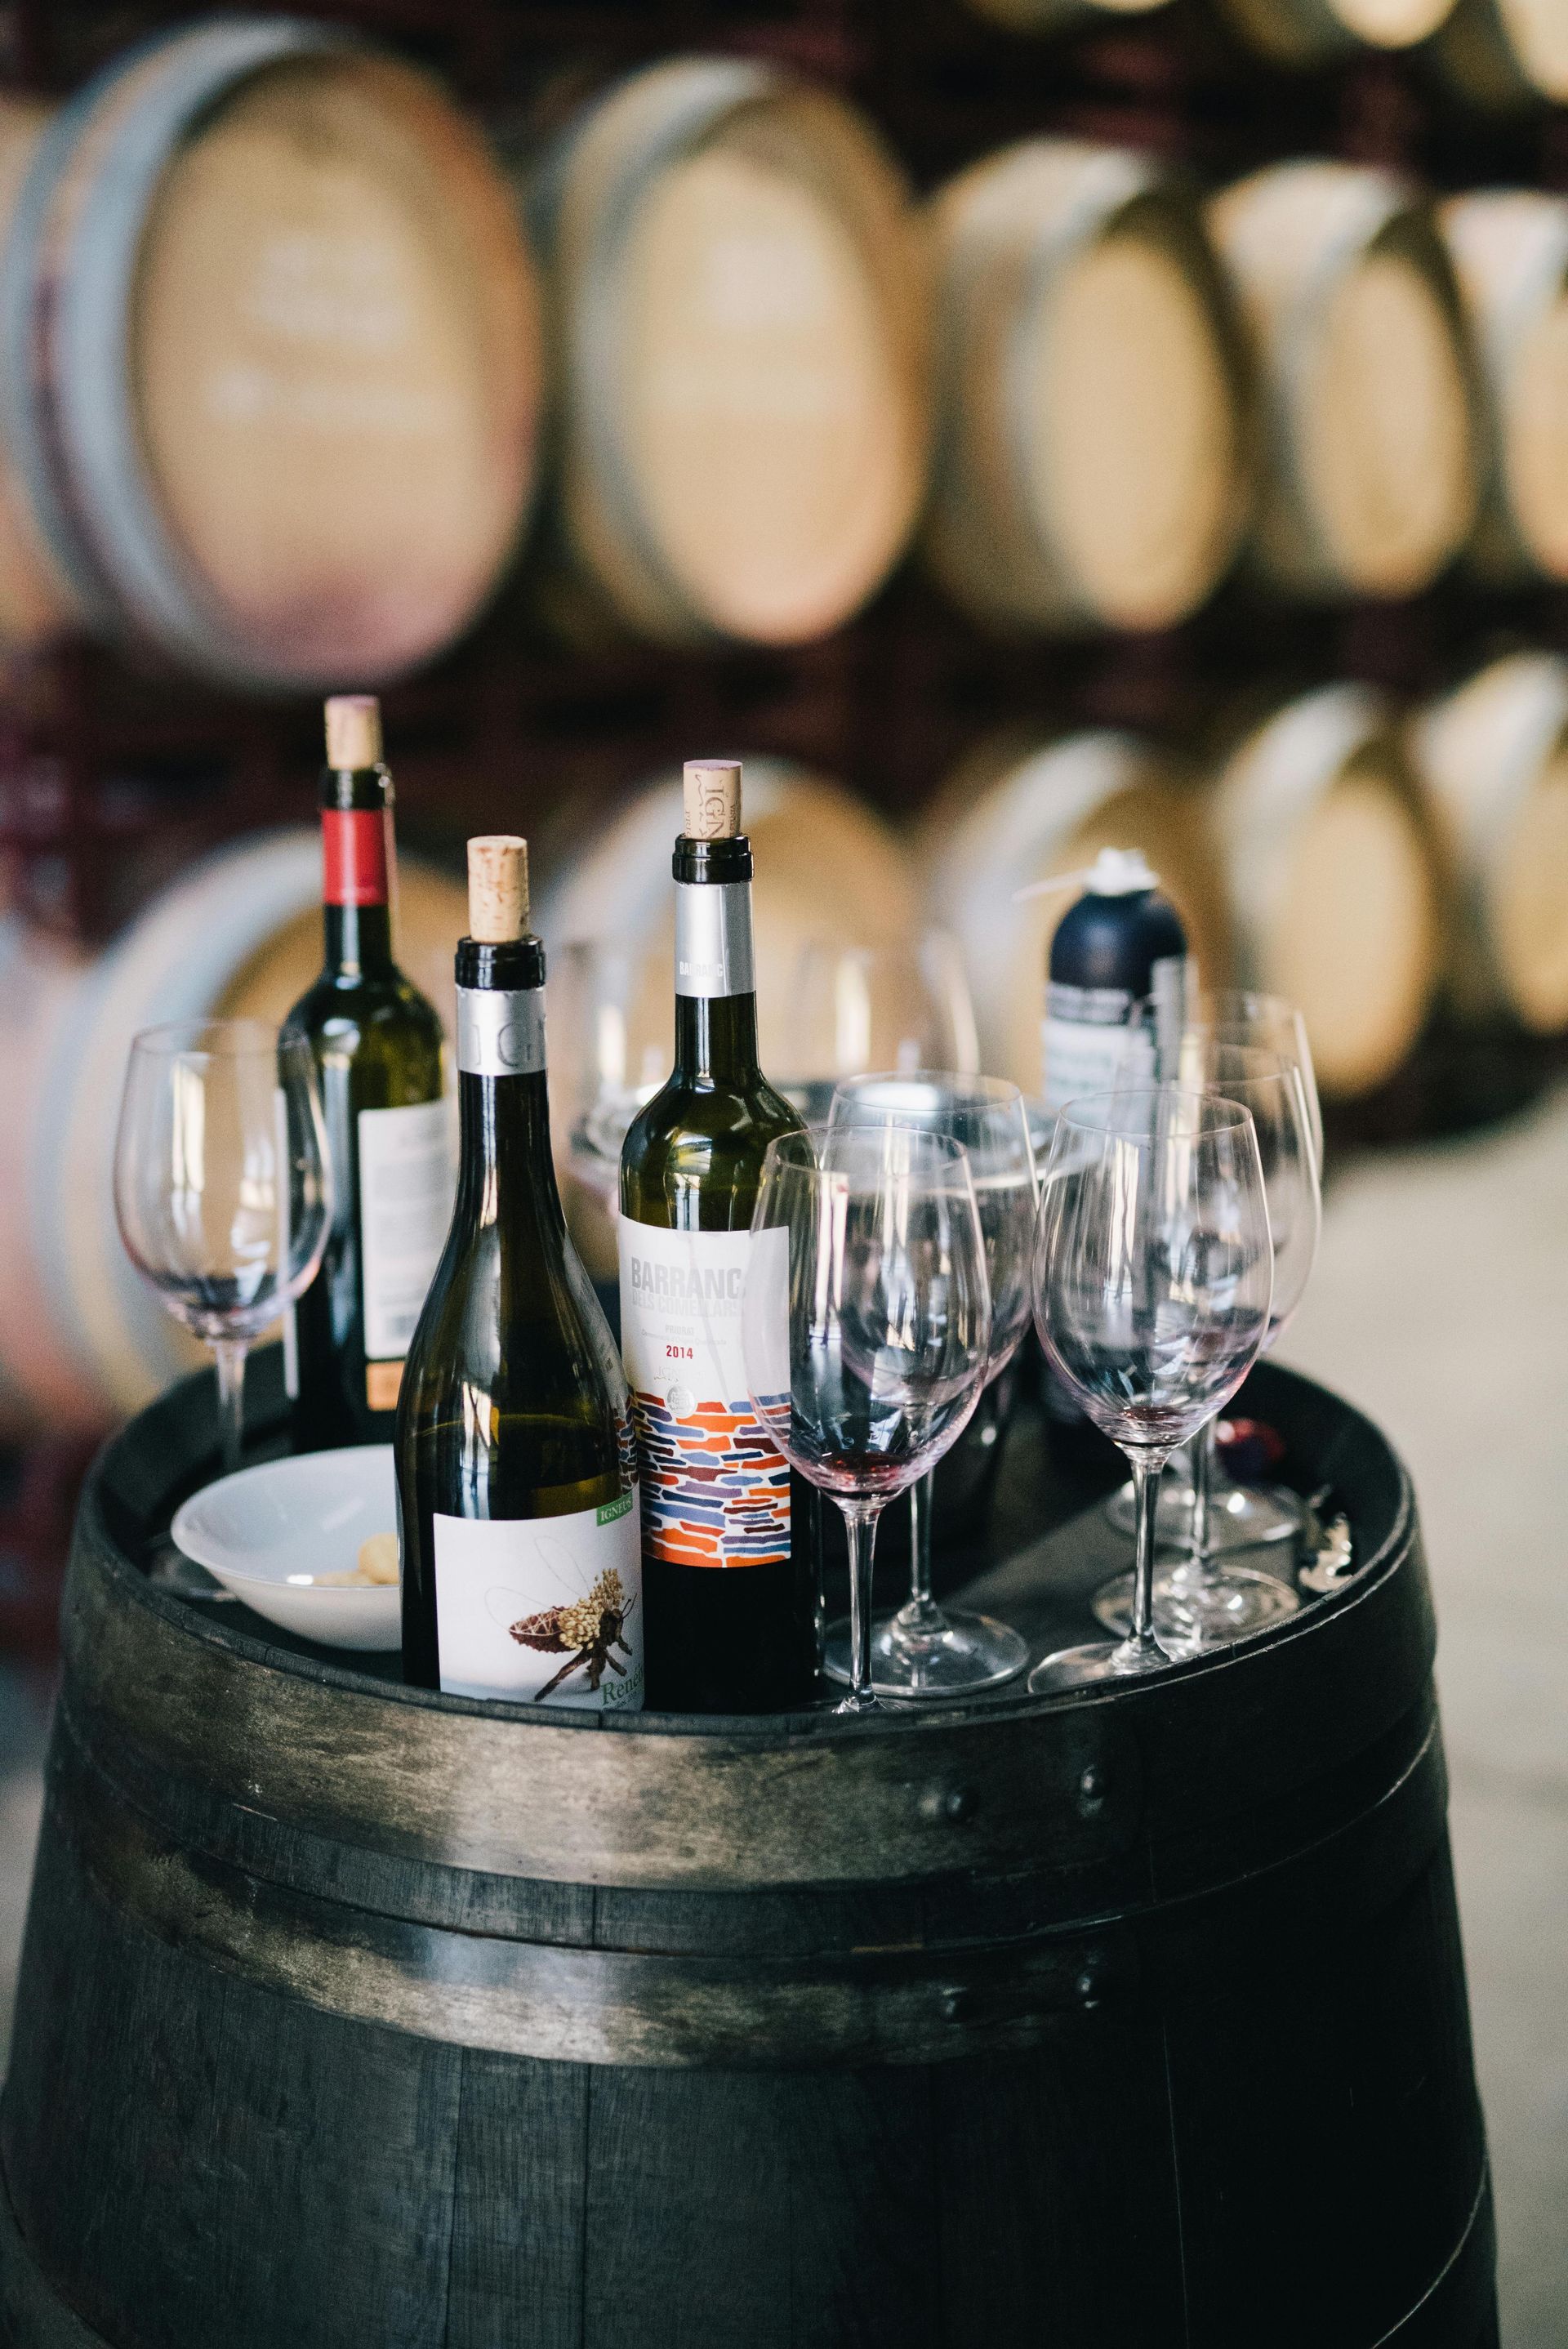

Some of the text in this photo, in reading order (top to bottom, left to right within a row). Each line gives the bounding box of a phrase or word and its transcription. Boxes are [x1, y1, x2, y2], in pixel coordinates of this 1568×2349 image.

[631, 1256, 742, 1299] BARRANC
[666, 1344, 693, 1359] 2014
[600, 1500, 631, 1522] IGNEUS
